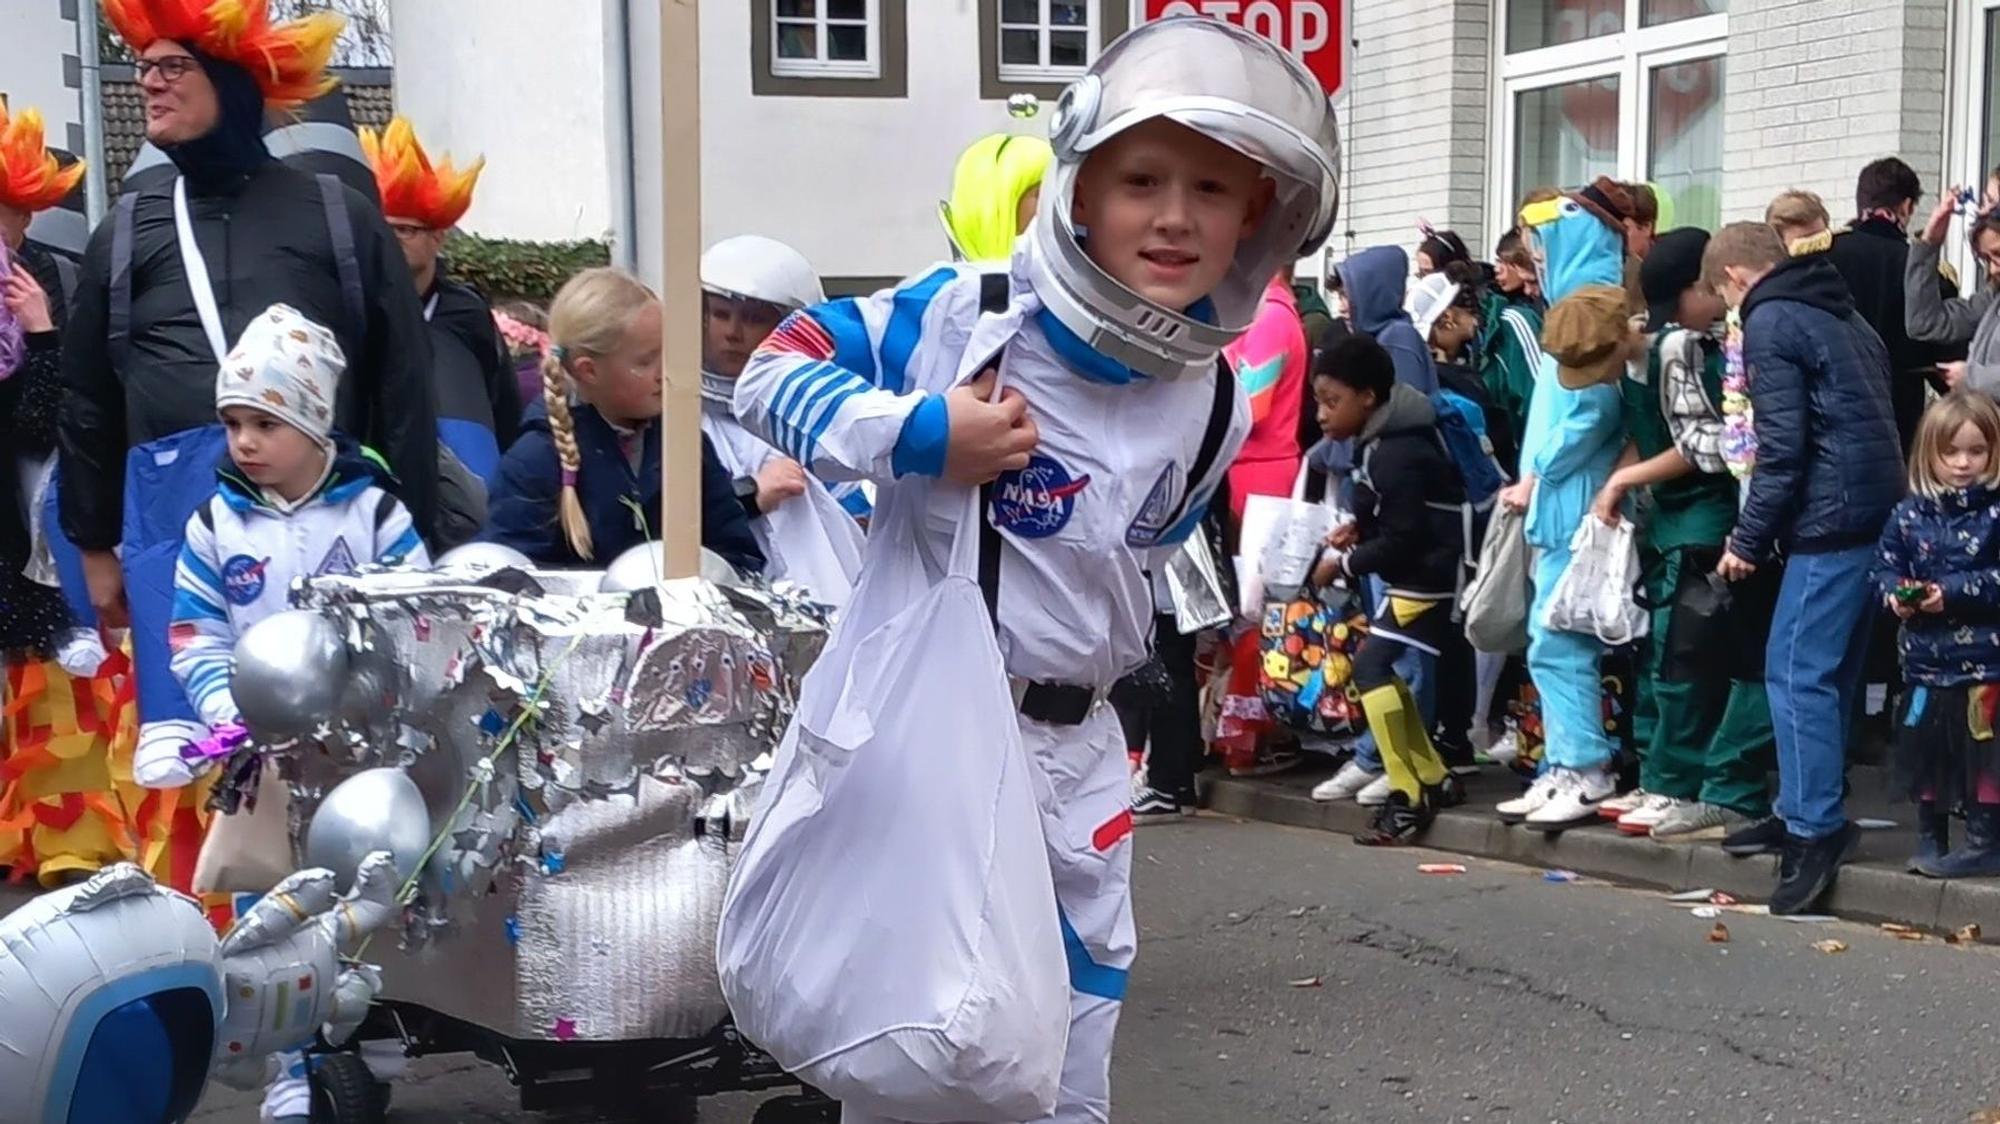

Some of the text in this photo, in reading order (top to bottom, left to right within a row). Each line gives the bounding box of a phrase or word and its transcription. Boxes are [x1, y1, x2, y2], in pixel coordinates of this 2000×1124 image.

[1160, 1, 1329, 62] TOP
[1002, 482, 1065, 516] NASA
[225, 572, 262, 587] NASA
